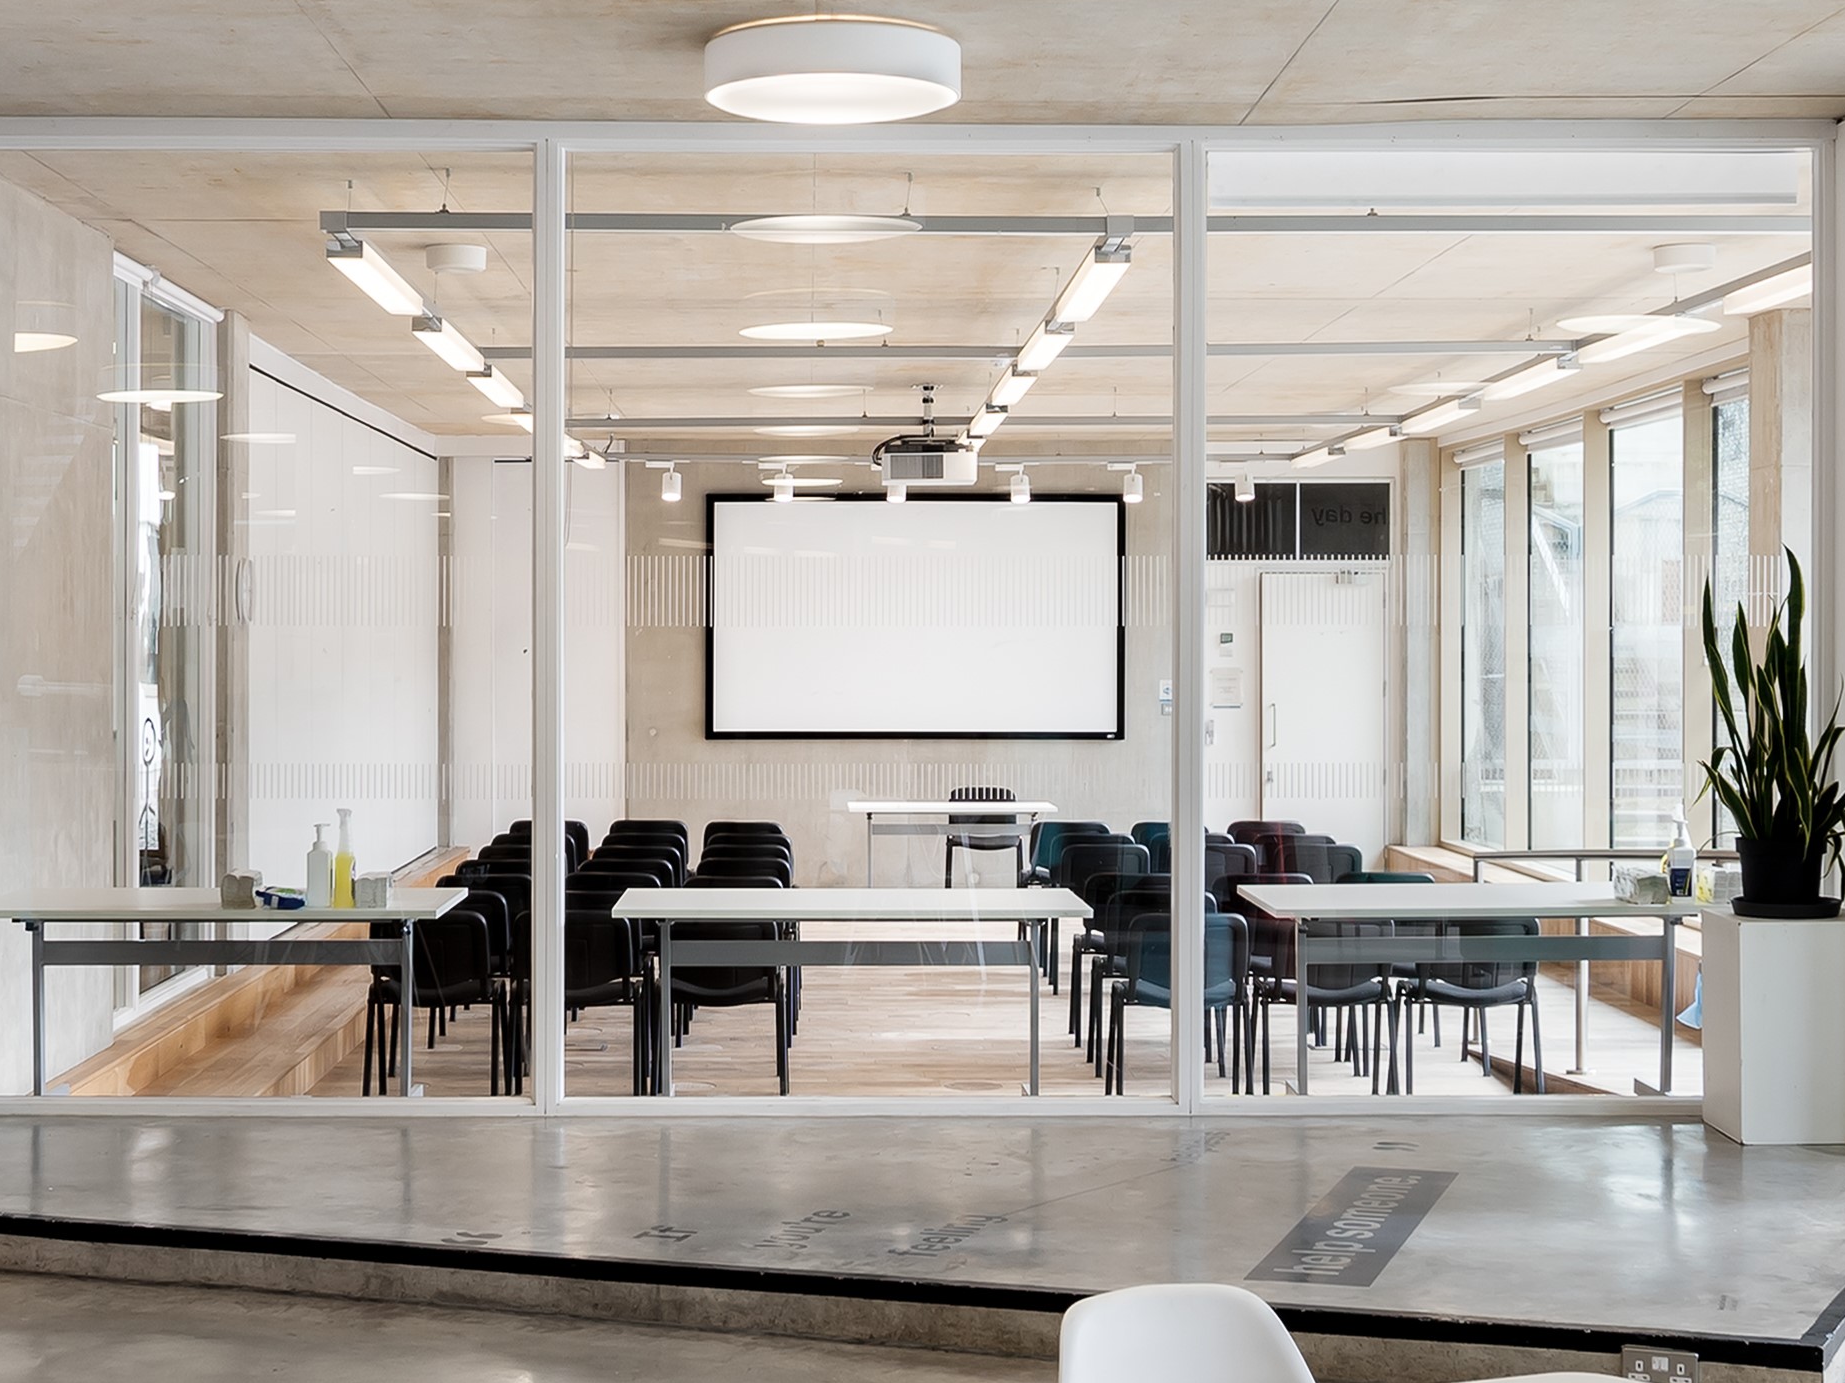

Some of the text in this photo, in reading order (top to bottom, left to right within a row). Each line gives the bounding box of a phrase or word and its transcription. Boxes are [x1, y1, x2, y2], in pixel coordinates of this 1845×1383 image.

[633, 1225, 698, 1243] If
[752, 1209, 853, 1250] you're
[888, 1214, 1008, 1257] feeling
[1273, 1240, 1376, 1277] help
